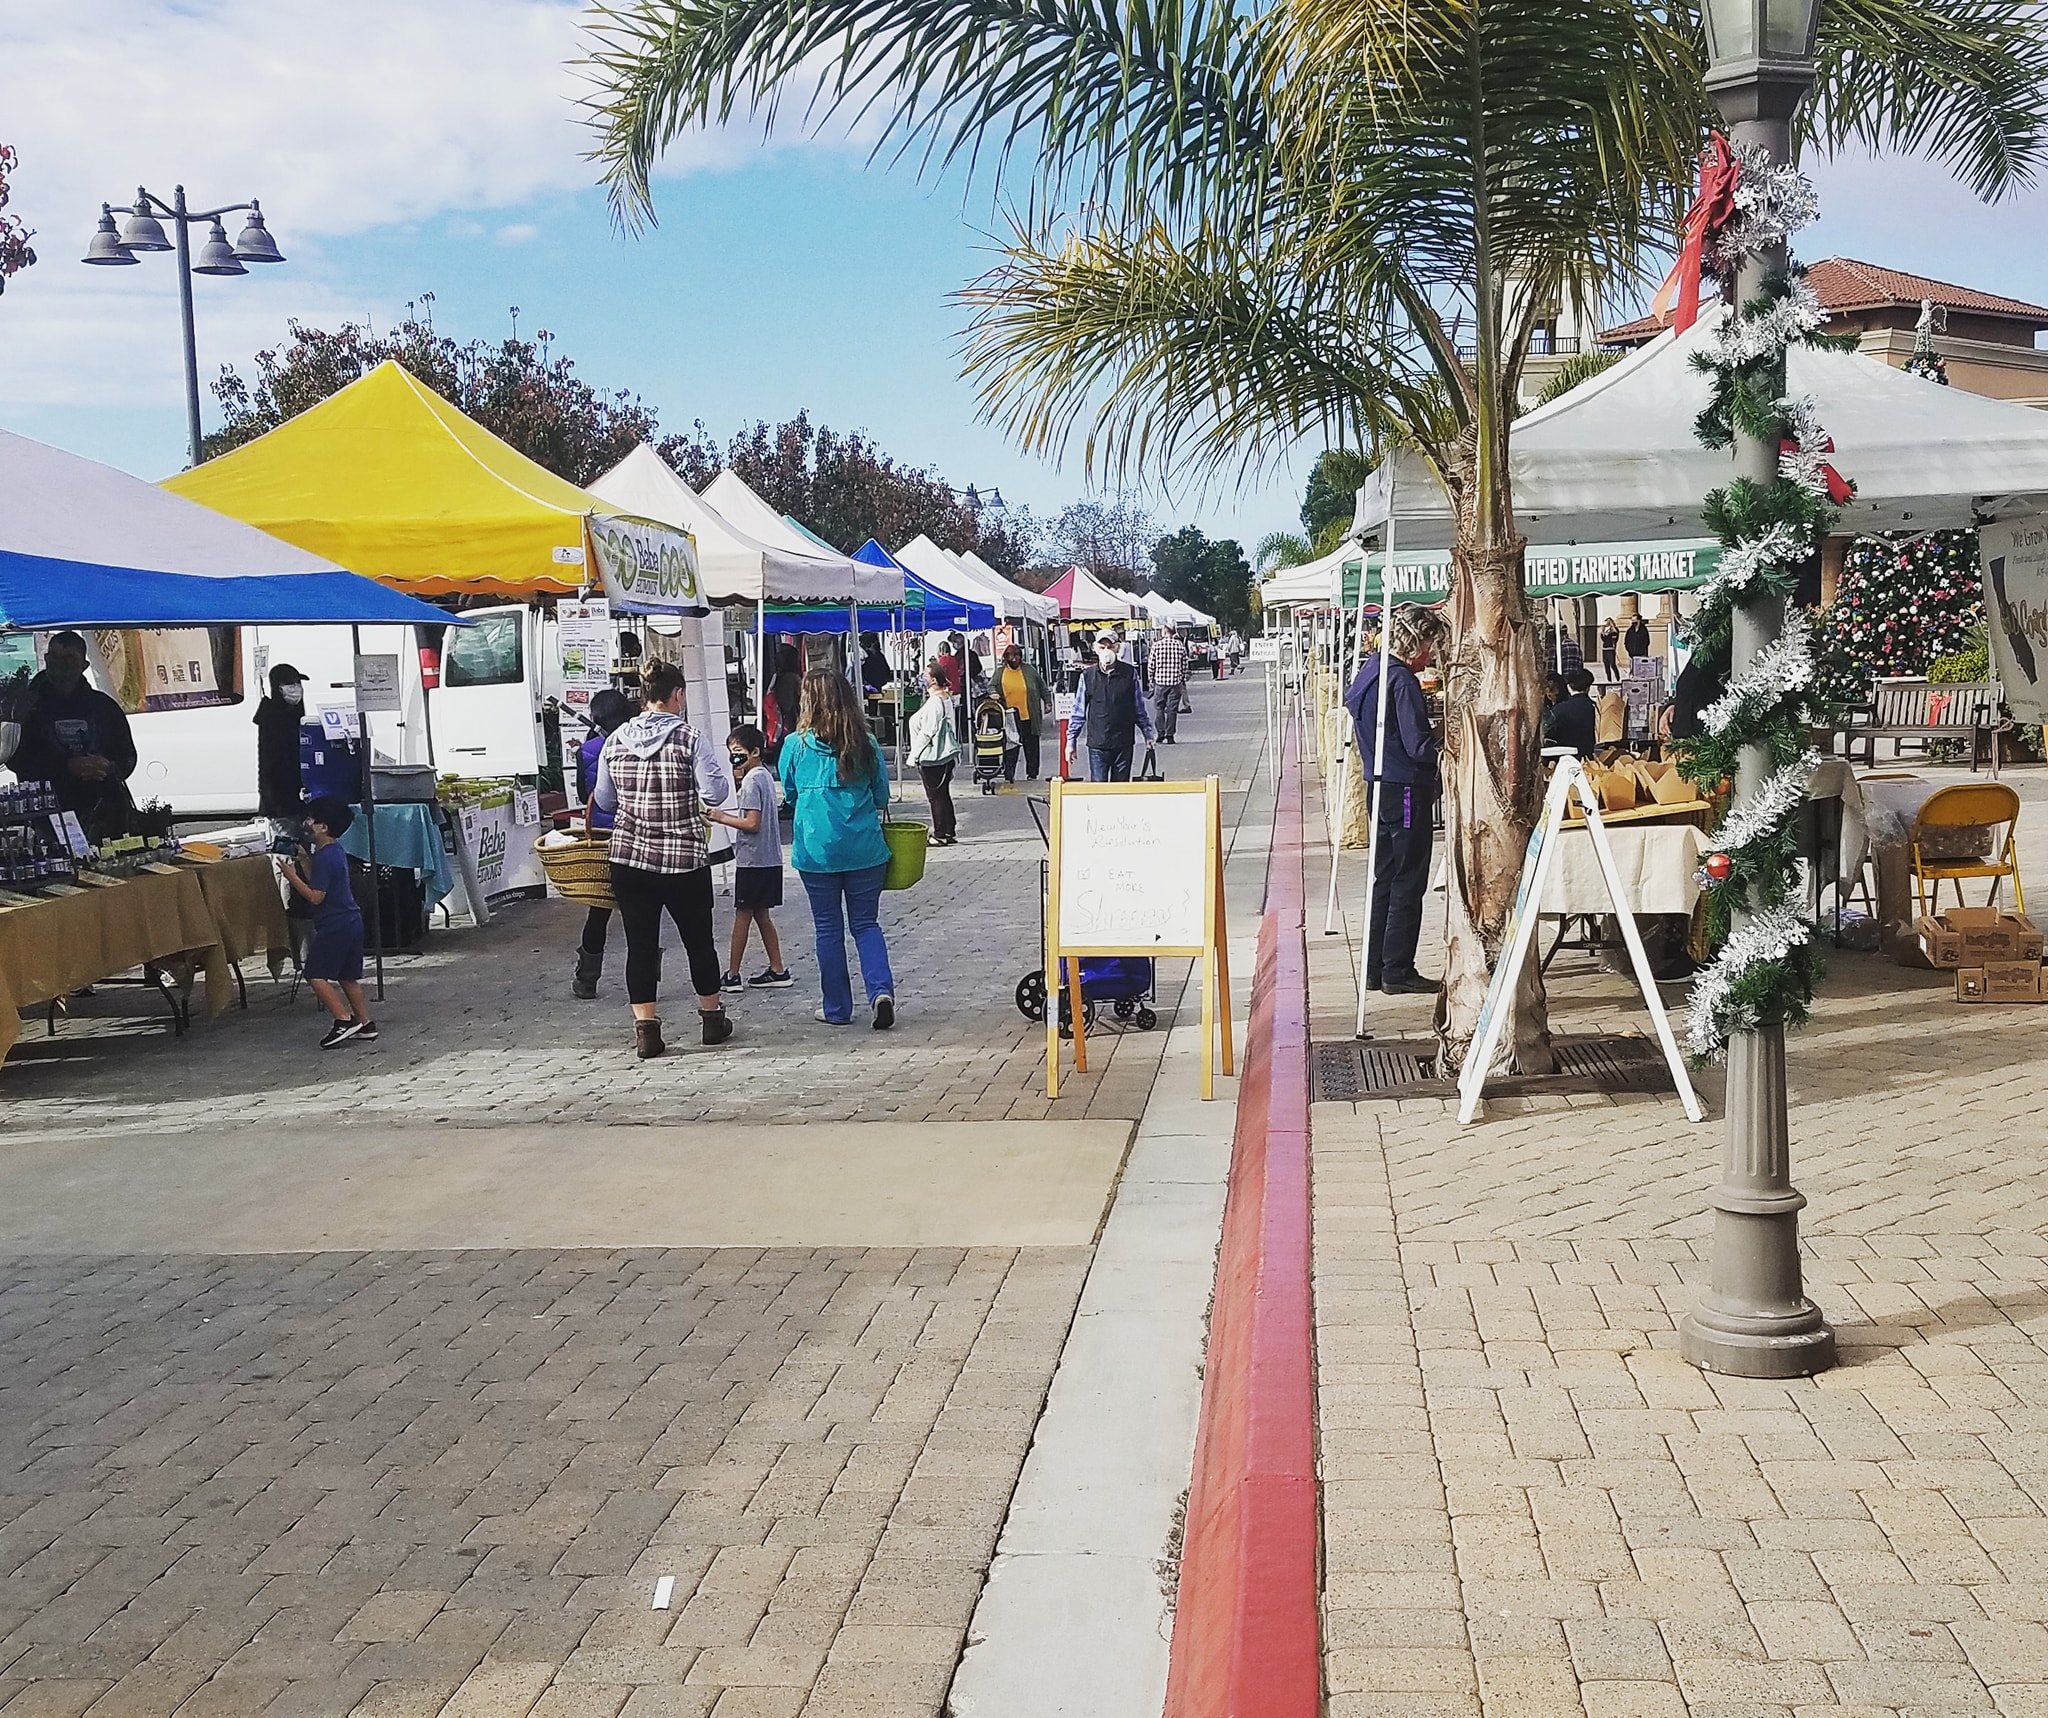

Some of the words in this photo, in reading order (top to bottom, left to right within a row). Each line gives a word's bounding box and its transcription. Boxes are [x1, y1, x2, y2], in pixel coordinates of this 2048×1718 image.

[635, 537, 660, 571] Baba
[1381, 565, 1427, 592] SANTA
[1429, 563, 1452, 590] BA
[1524, 557, 1568, 586] TIFIED
[1571, 554, 1636, 584] FARMERS
[1639, 550, 1696, 580] MARKET
[479, 820, 506, 859] Baba
